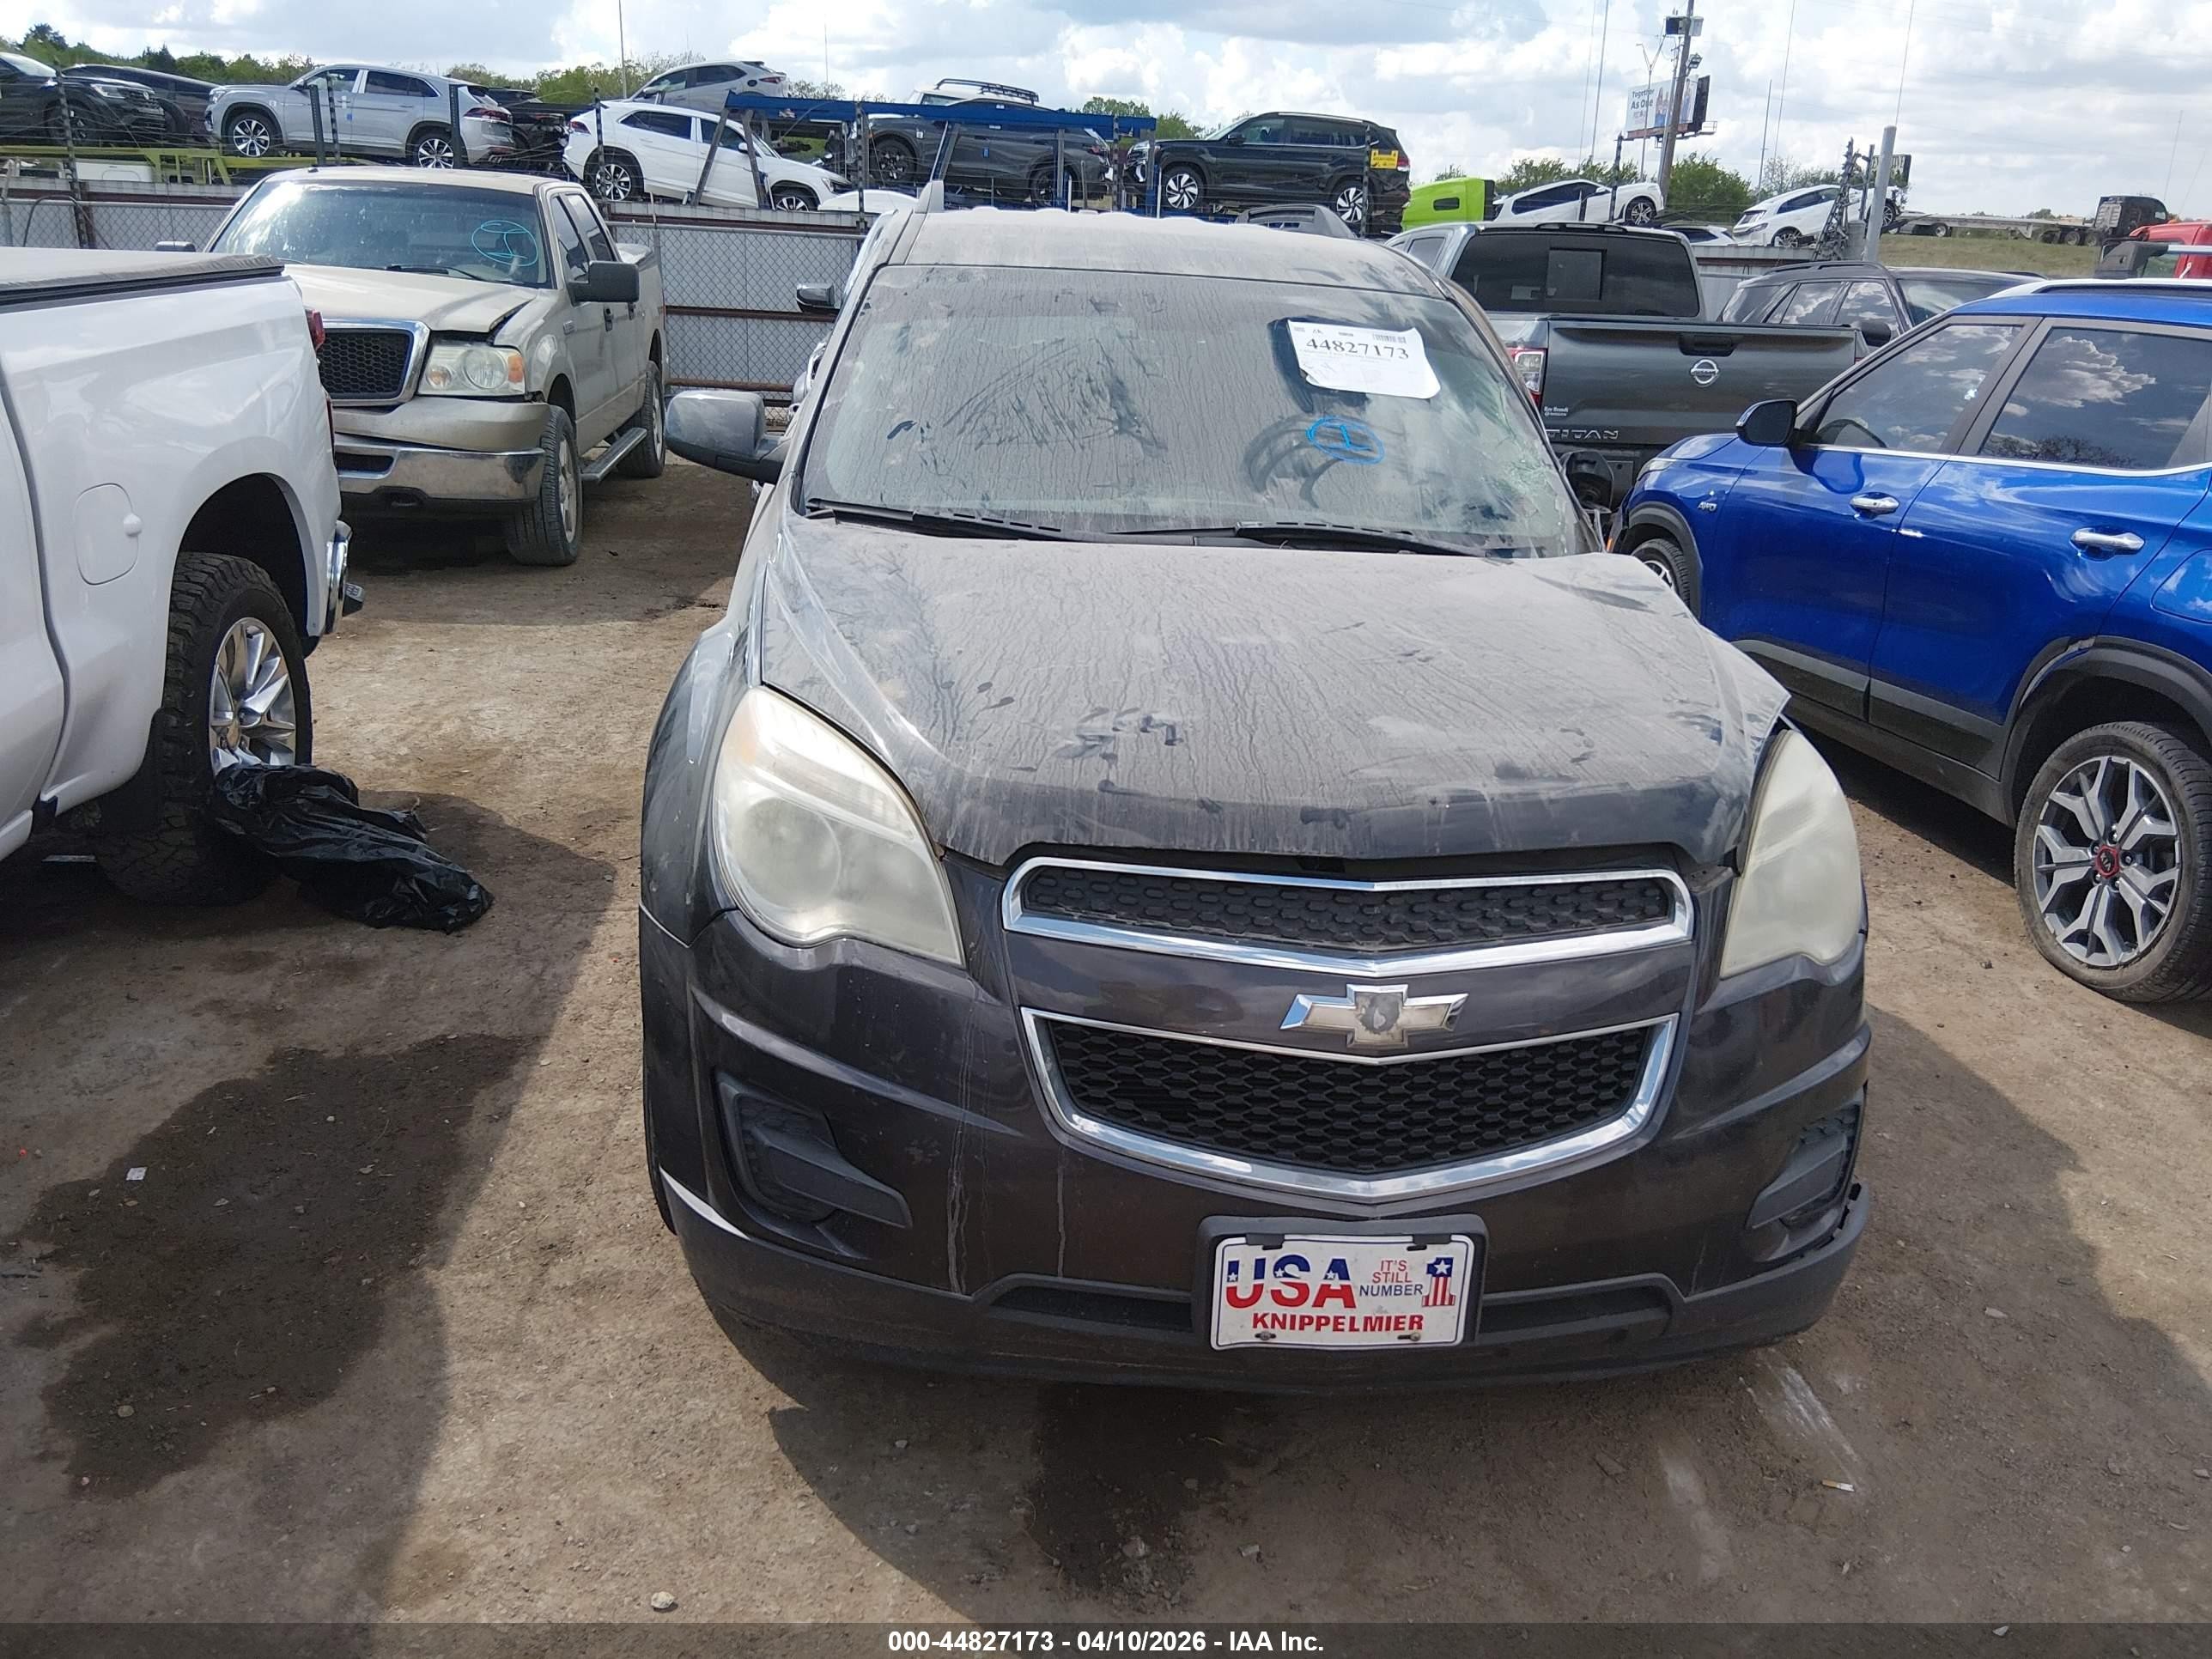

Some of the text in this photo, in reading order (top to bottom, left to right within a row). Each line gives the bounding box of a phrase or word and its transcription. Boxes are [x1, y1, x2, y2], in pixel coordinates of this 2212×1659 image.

[1632, 89, 1655, 98] Together
[1631, 100, 1639, 110] As
[1306, 337, 1409, 360] 44827173
[1545, 428, 1619, 440] TITAN
[1380, 1260, 1407, 1272] IT'S
[1225, 1254, 1357, 1310] USA
[1371, 1272, 1413, 1283] STILL
[1359, 1284, 1424, 1297] NUMBER
[1252, 1312, 1425, 1333] KNIPPELMIER
